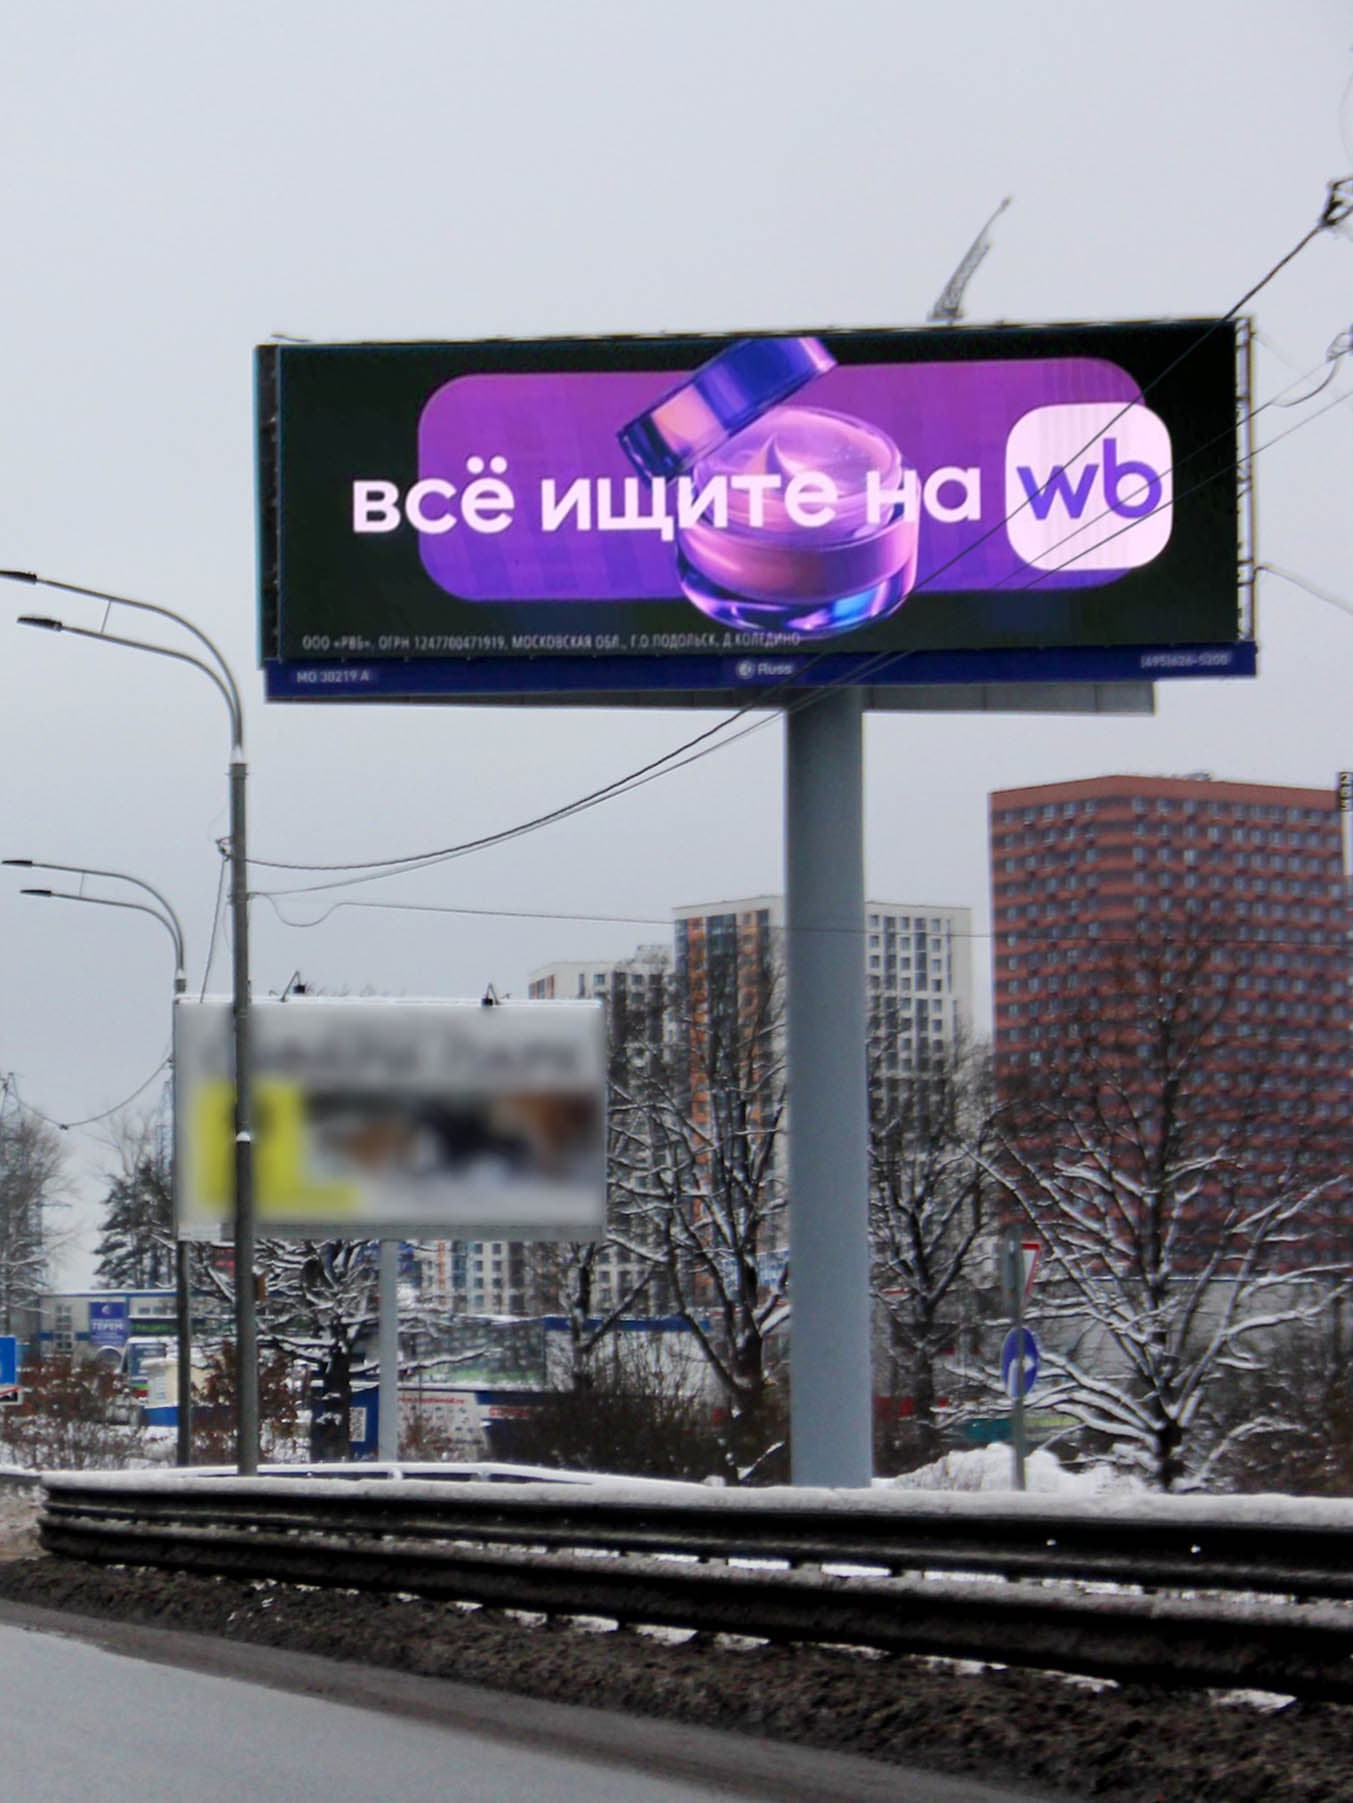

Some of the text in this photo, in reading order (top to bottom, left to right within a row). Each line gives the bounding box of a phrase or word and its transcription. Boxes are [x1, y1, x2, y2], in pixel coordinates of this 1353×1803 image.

[1016, 437, 1163, 520] wb
[353, 456, 982, 541] всё ищите на
[302, 635, 330, 650] ООО
[379, 635, 409, 650] ОГРН
[512, 633, 592, 649] МОСКОВСКАЯ
[297, 670, 316, 683] МО
[757, 663, 793, 675] Russ
